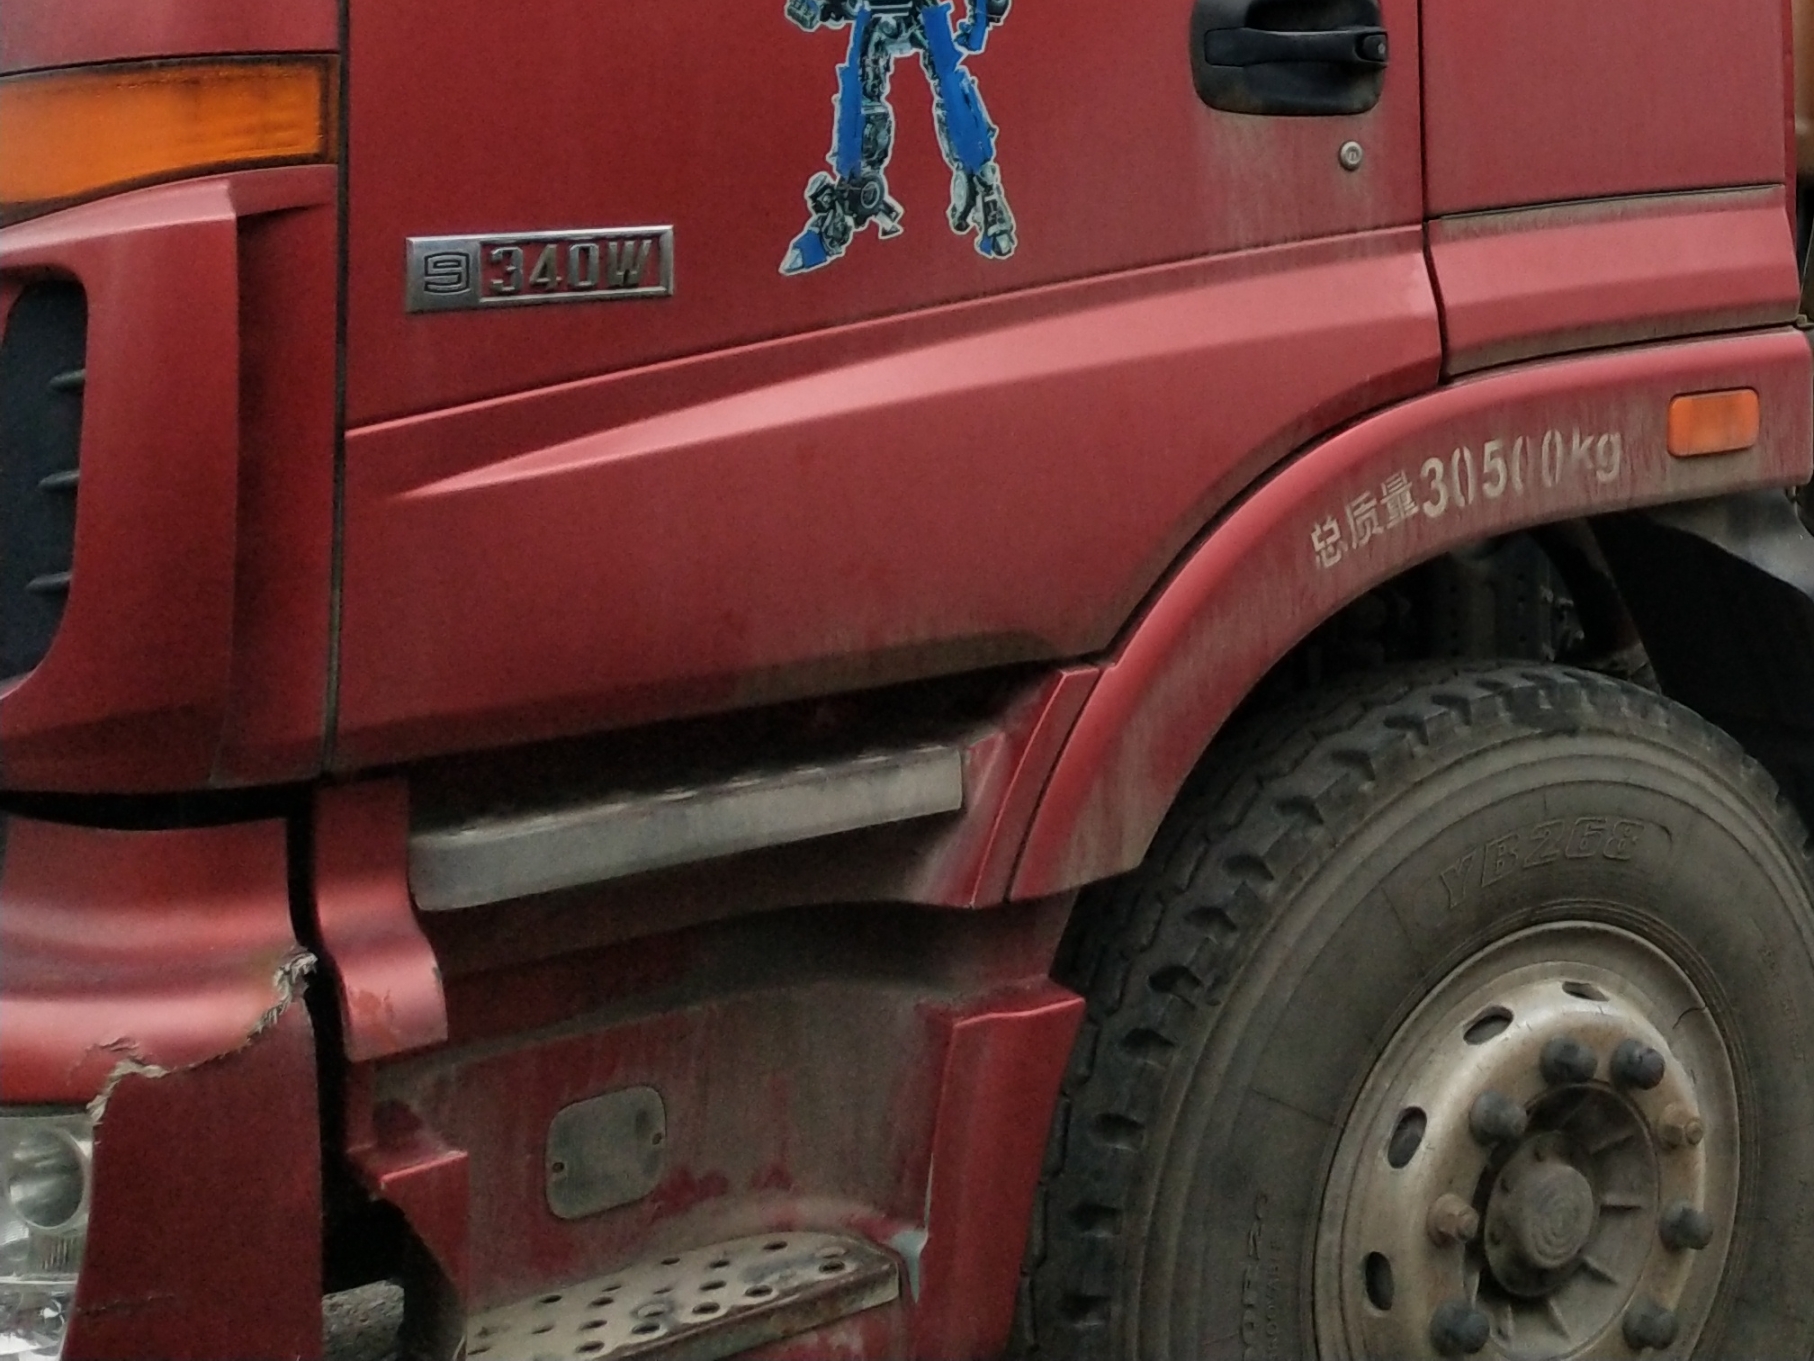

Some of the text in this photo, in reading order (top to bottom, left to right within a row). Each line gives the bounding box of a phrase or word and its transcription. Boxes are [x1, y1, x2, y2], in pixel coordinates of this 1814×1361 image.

[488, 240, 652, 295] 340W
[1310, 427, 1622, 569] 总质量 30500kg
